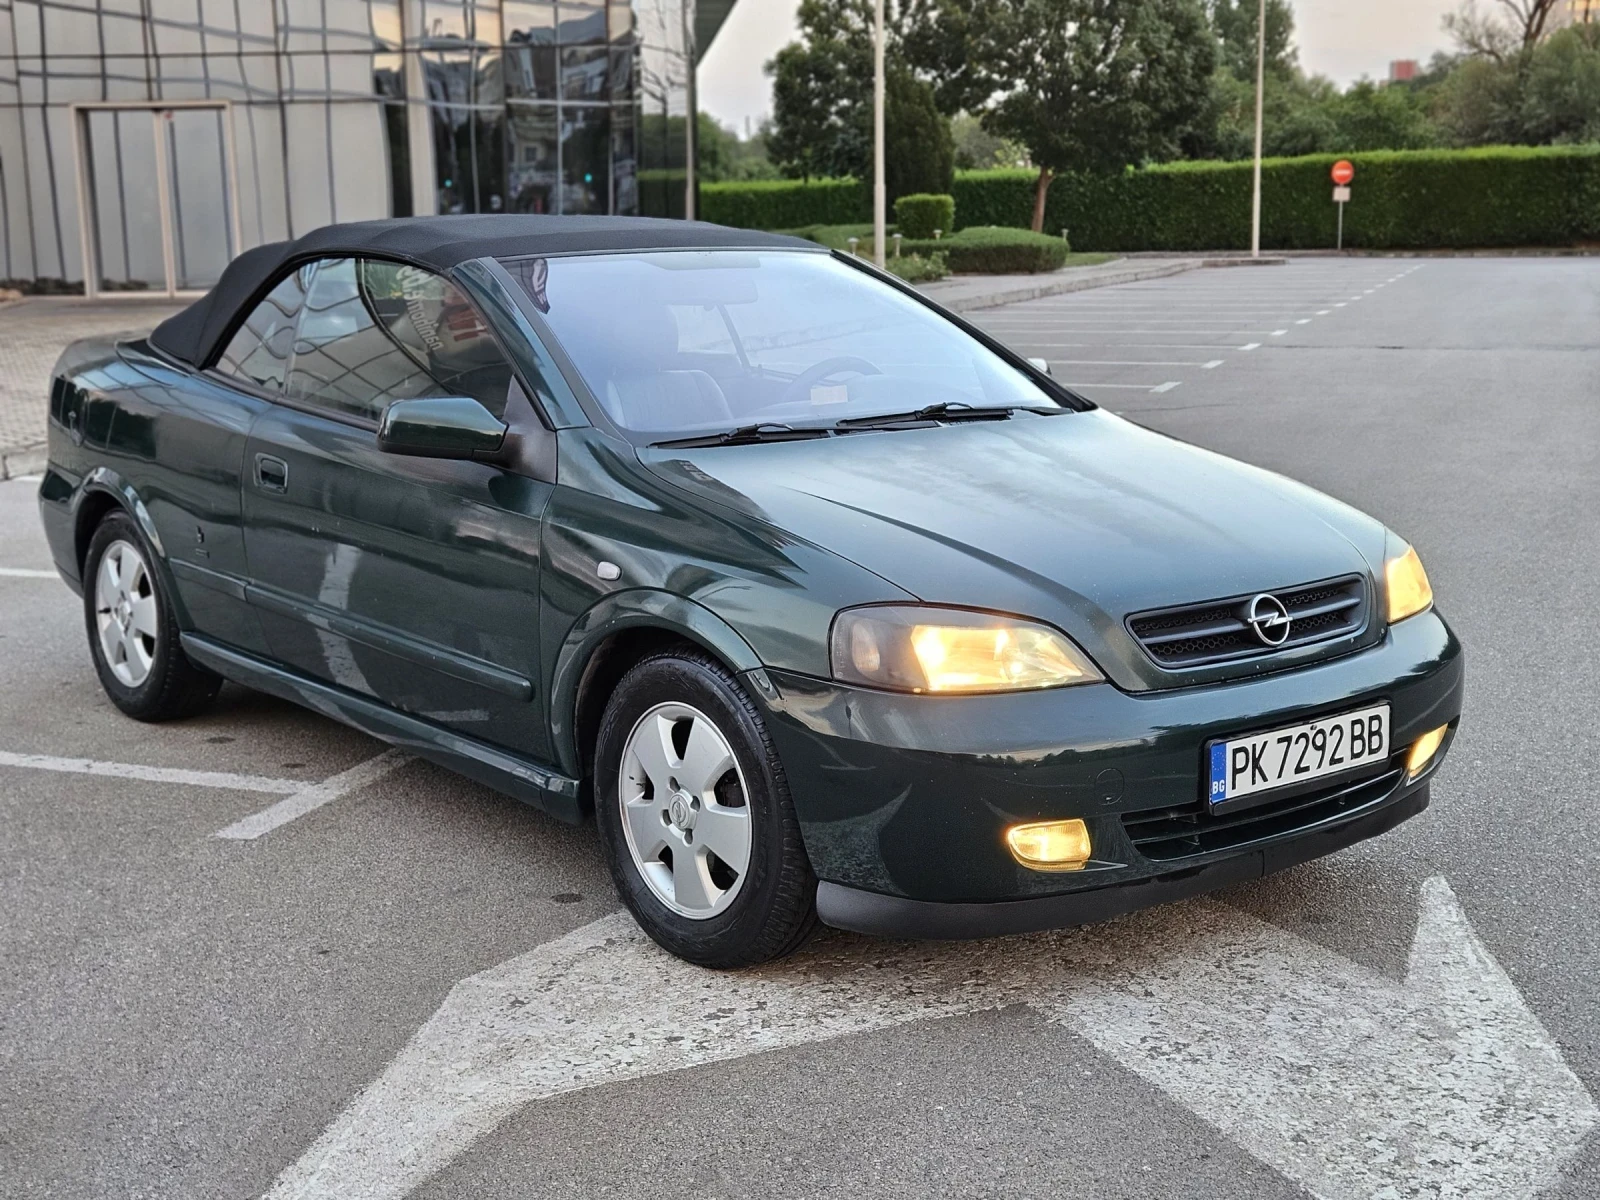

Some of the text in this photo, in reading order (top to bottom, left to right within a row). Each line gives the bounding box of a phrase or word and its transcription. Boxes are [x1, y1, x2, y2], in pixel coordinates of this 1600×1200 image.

[1231, 714, 1384, 790] PK 7292 BB
[1212, 780, 1225, 795] BG
